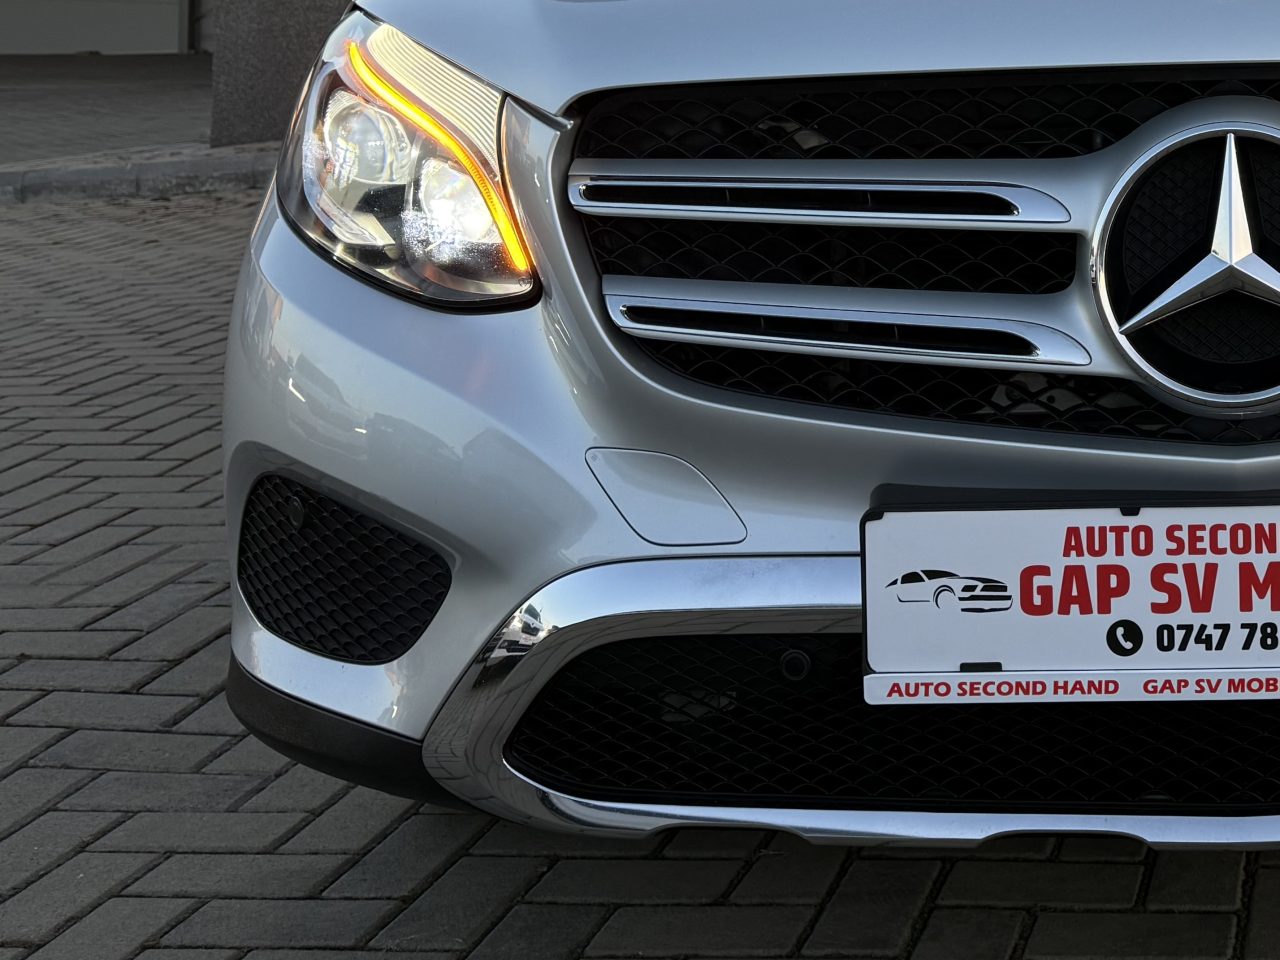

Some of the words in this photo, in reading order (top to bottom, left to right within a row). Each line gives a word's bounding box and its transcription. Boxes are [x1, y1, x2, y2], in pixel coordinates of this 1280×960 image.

[1062, 525, 1154, 558] AUTO
[1019, 564, 1131, 616] GAP
[1150, 562, 1219, 615] SV
[1156, 623, 1231, 652] 0747
[886, 681, 952, 698] AUTO
[956, 680, 1048, 697] SECOND
[1052, 679, 1120, 696] HAND
[1142, 678, 1190, 695] GAP
[1194, 678, 1223, 694] SV
